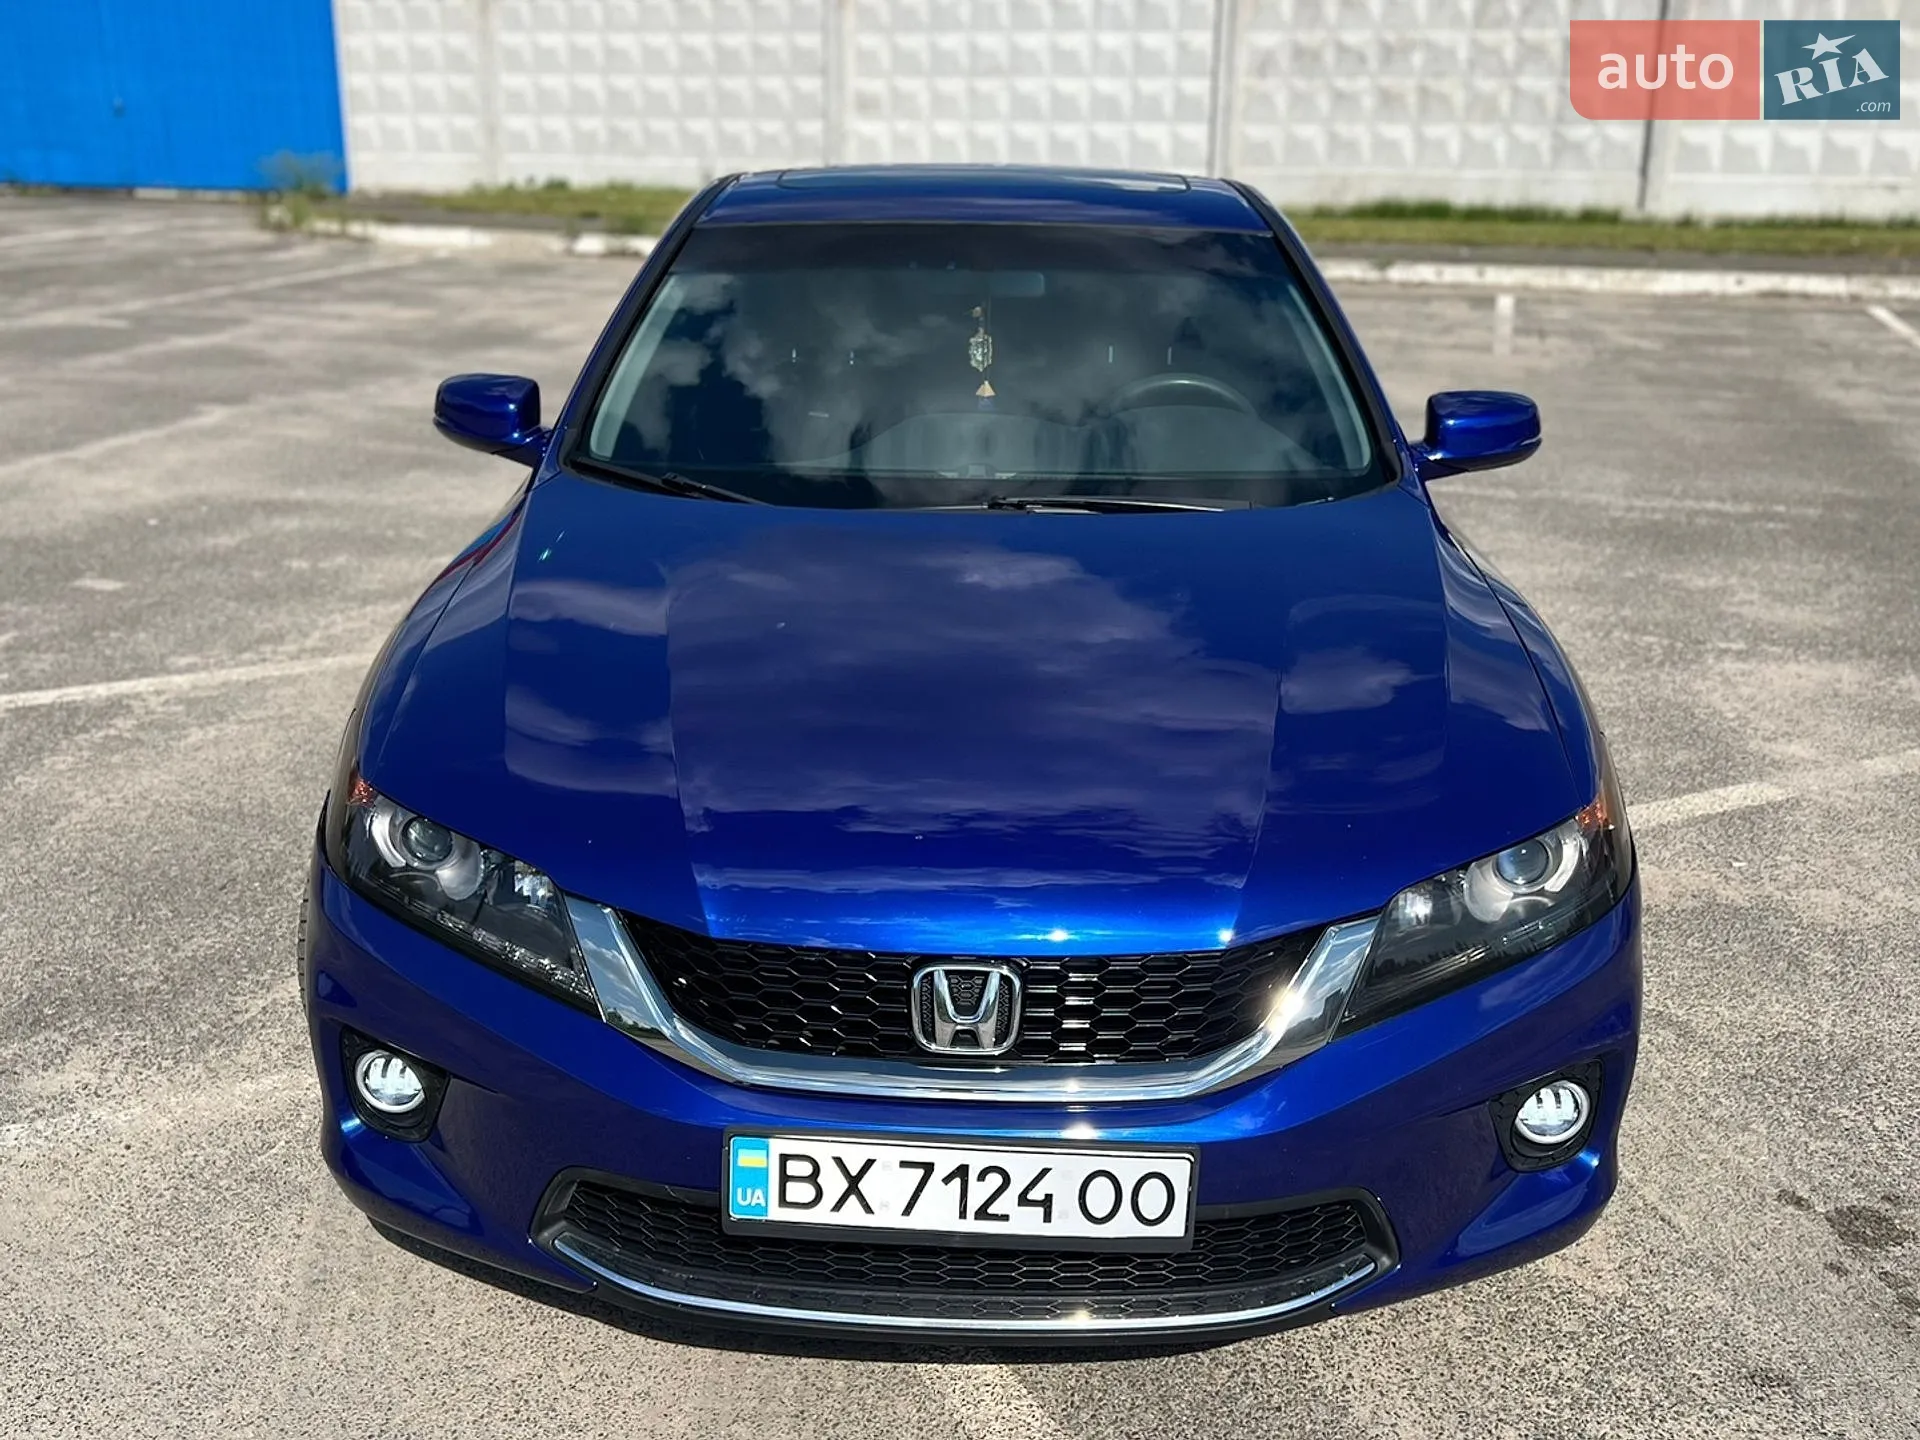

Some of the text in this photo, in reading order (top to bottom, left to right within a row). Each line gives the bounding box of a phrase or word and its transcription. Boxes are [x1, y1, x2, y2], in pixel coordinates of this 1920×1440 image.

[737, 1187, 766, 1208] UA
[778, 1153, 877, 1215] BX
[899, 1160, 1054, 1224] 7124
